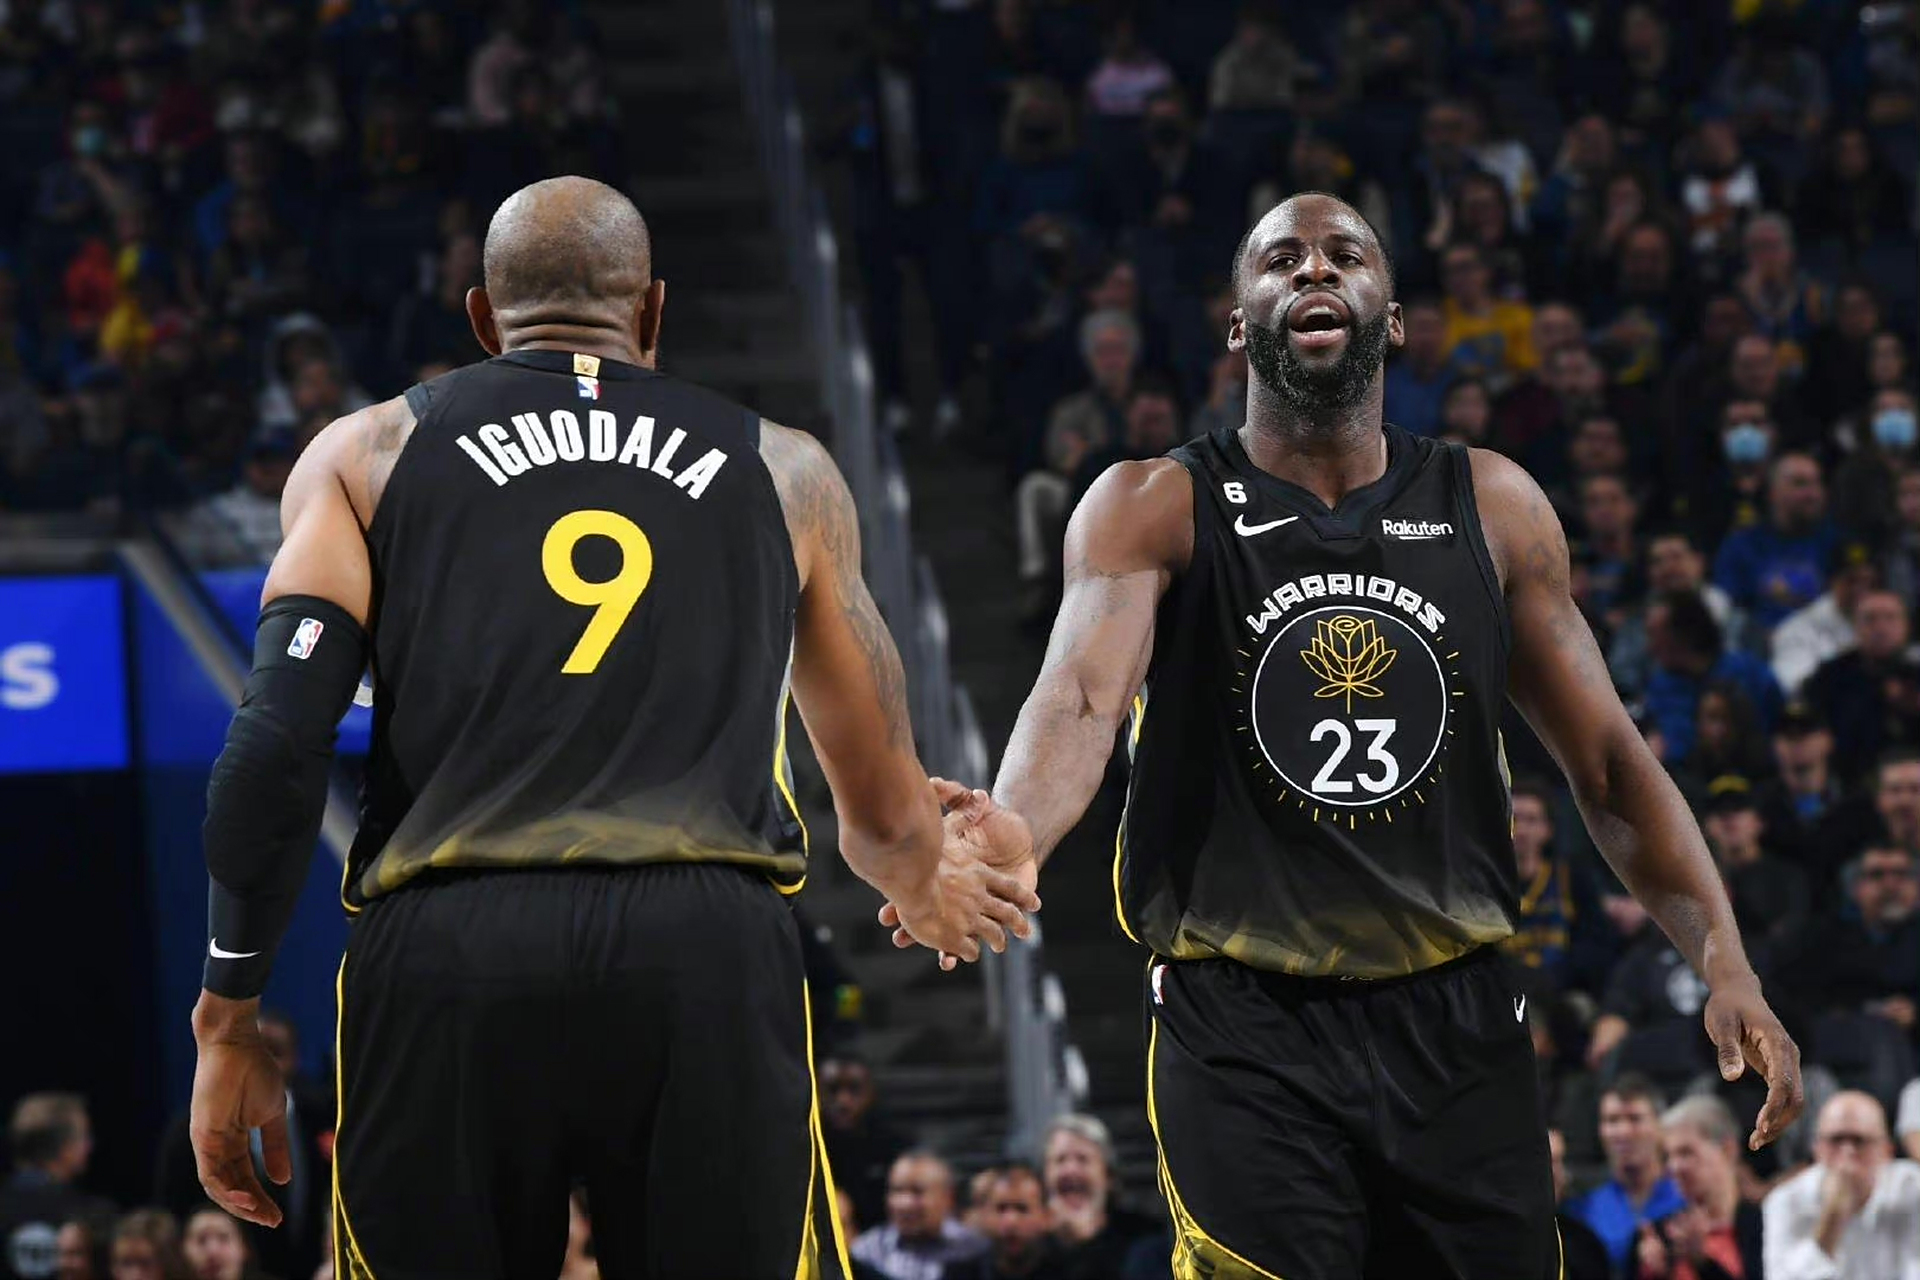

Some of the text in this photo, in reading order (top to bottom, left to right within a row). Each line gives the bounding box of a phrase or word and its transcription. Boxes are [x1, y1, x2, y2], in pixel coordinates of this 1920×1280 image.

[456, 410, 728, 500] IGUODALA
[1223, 482, 1248, 504] 6
[1382, 519, 1454, 538] Rakuten
[542, 510, 653, 673] 9
[1246, 573, 1446, 634] WARRIORS
[1310, 718, 1399, 793] 23
